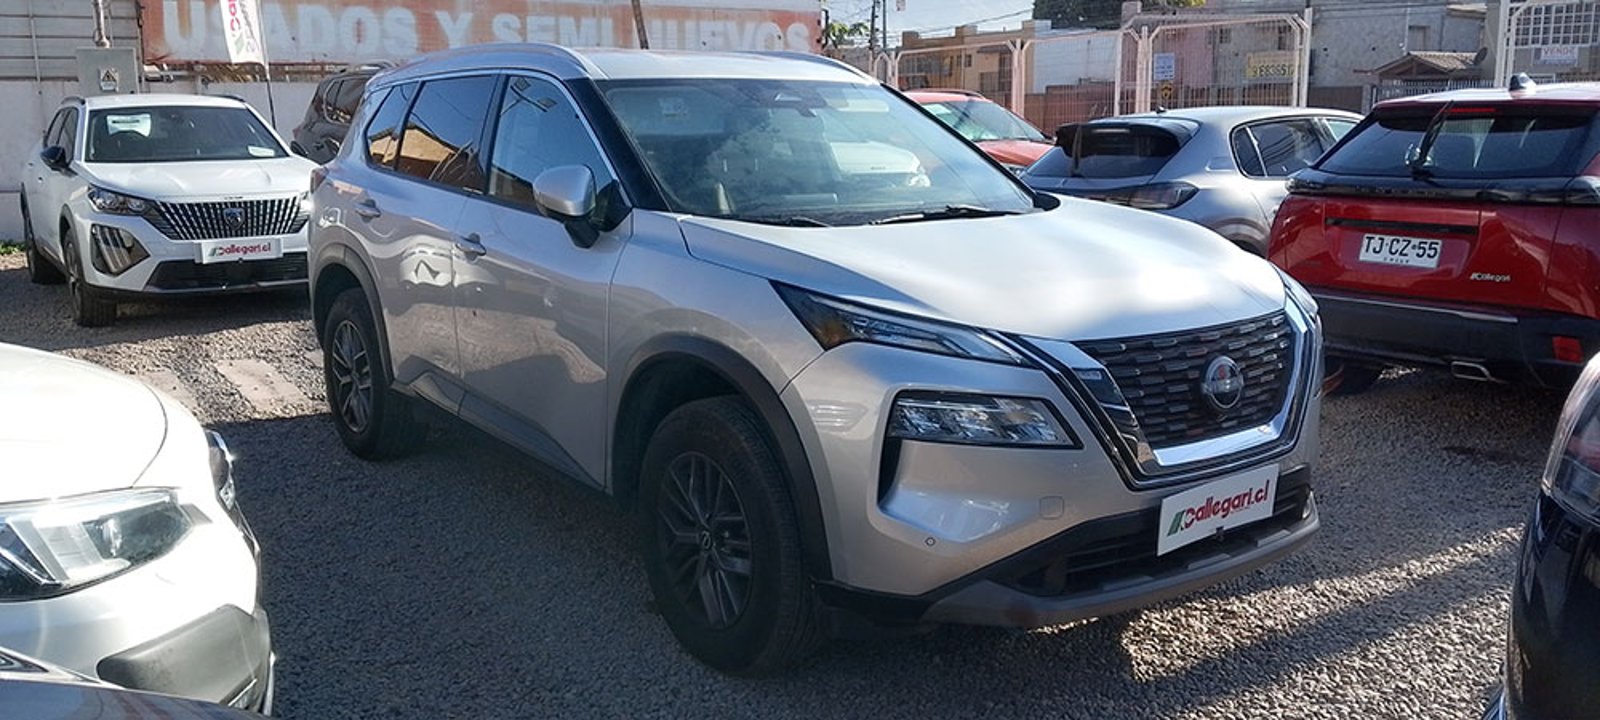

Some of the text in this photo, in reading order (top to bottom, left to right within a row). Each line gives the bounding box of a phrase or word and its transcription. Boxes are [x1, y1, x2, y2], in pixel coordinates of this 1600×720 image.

[163, 0, 418, 57] UADOS
[435, 10, 473, 48] Y
[1184, 480, 1270, 529] Callegari.cl
